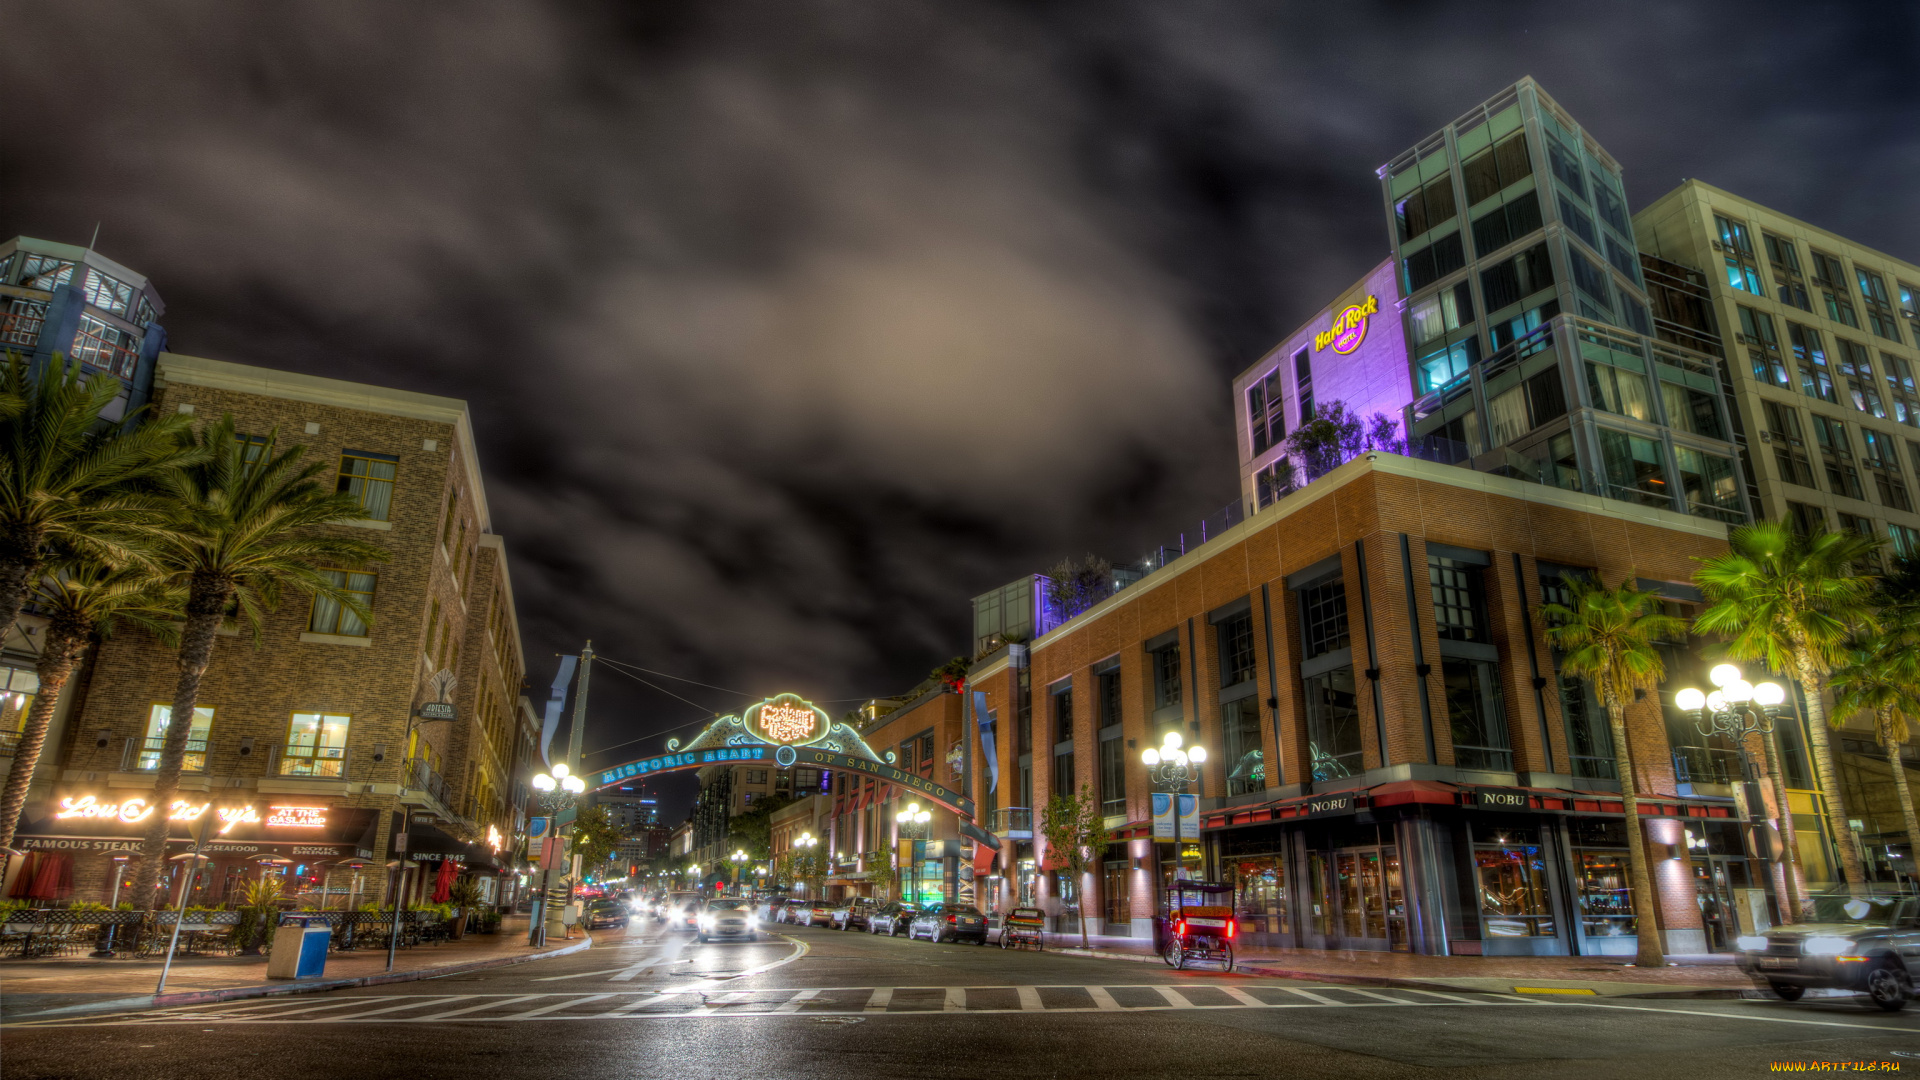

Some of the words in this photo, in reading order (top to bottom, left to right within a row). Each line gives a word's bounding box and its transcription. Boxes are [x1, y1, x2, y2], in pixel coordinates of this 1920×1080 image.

[1315, 316, 1345, 352] Hard
[1346, 295, 1379, 329] Rock
[1338, 332, 1357, 348] HOTEL
[426, 704, 452, 713] ARTESIA
[602, 752, 696, 783] HISTORIC
[704, 747, 763, 762] HEART
[814, 752, 835, 763] OF
[847, 758, 880, 773] SAN
[892, 770, 945, 797] DIEGO
[1311, 799, 1347, 812] NOBU
[1484, 793, 1525, 806] NOBU
[56, 796, 118, 818] Lou
[278, 809, 295, 817] AT
[296, 809, 320, 817] THE
[268, 816, 326, 825] GASLAMP
[22, 839, 90, 850] FAMOUS
[93, 841, 146, 851] STEAK
[413, 852, 441, 861] SINCE
[445, 854, 466, 862] 1945
